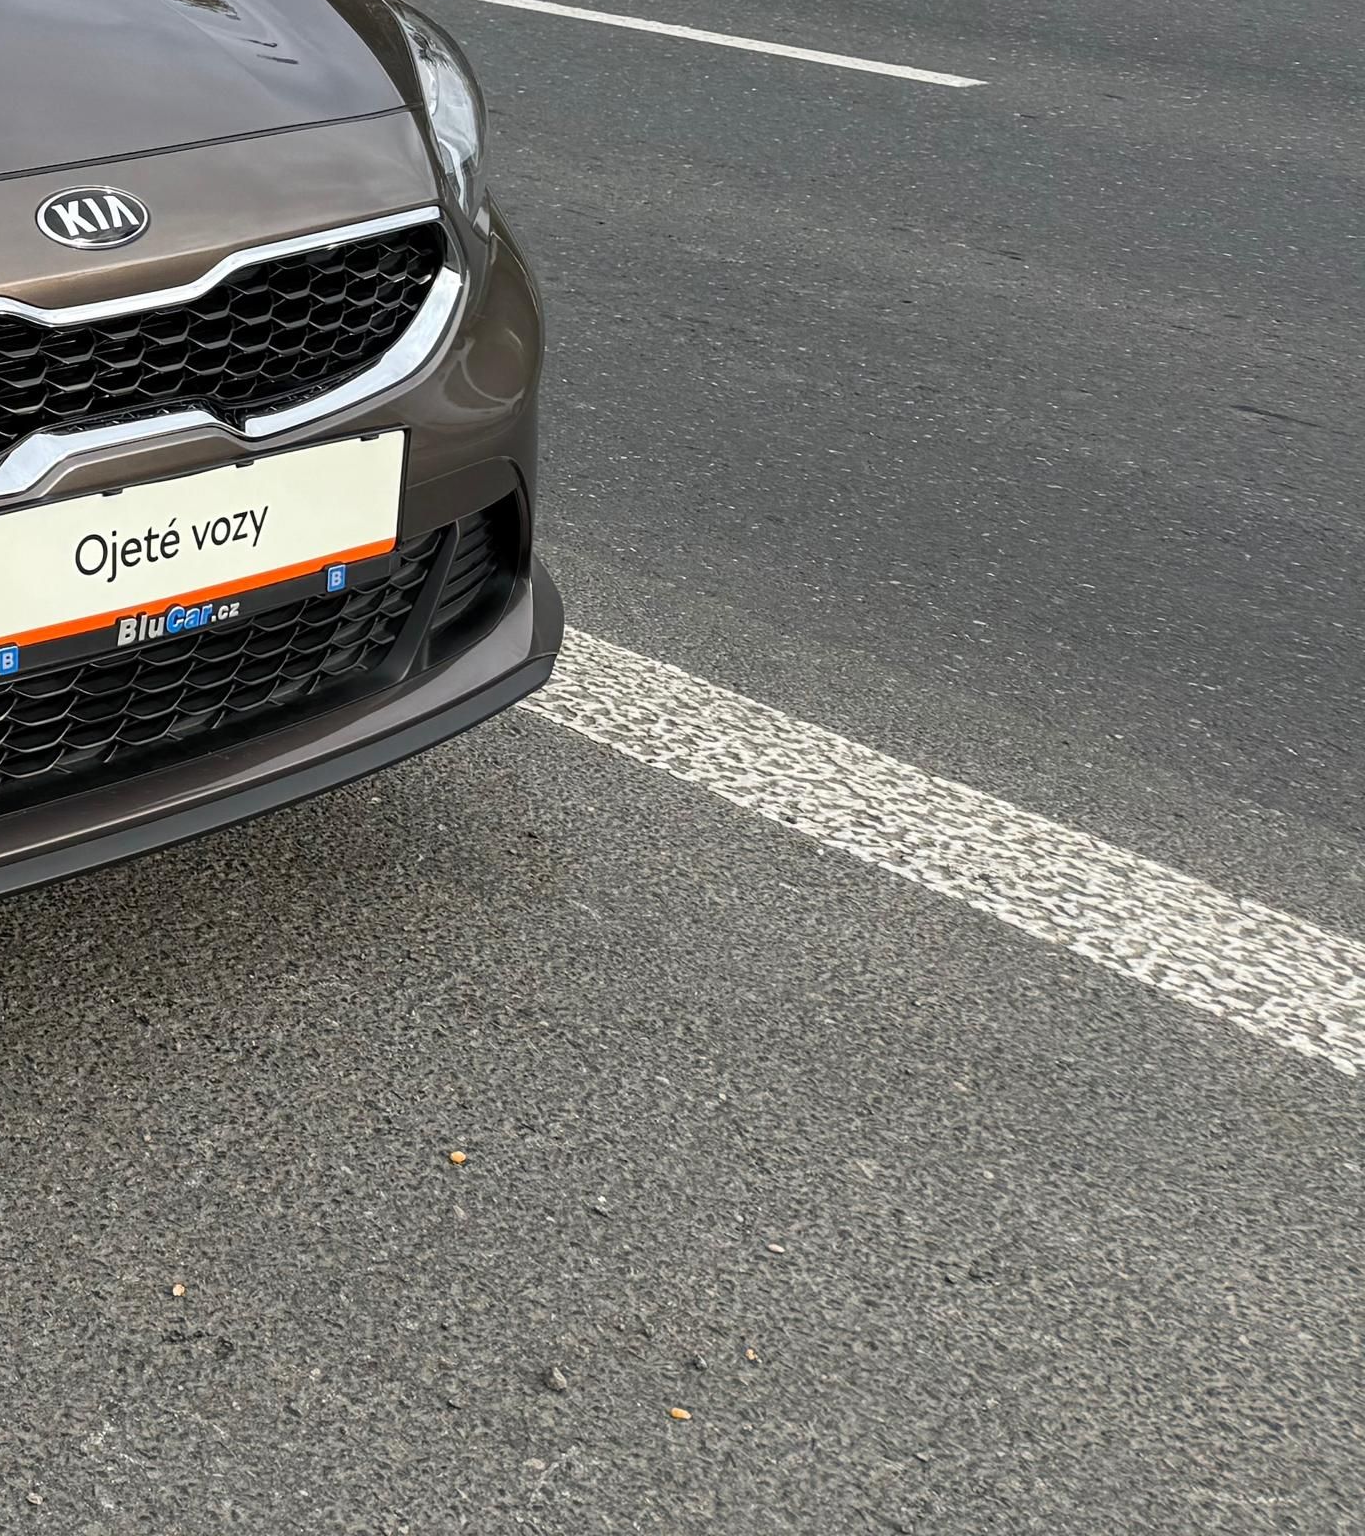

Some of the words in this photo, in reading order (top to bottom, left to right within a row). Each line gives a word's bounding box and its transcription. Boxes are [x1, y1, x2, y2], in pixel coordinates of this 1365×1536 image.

[51, 195, 139, 237] KIA
[75, 517, 180, 583] Ojeté
[192, 505, 269, 551] vozy
[116, 600, 240, 647] BluCar.cz
